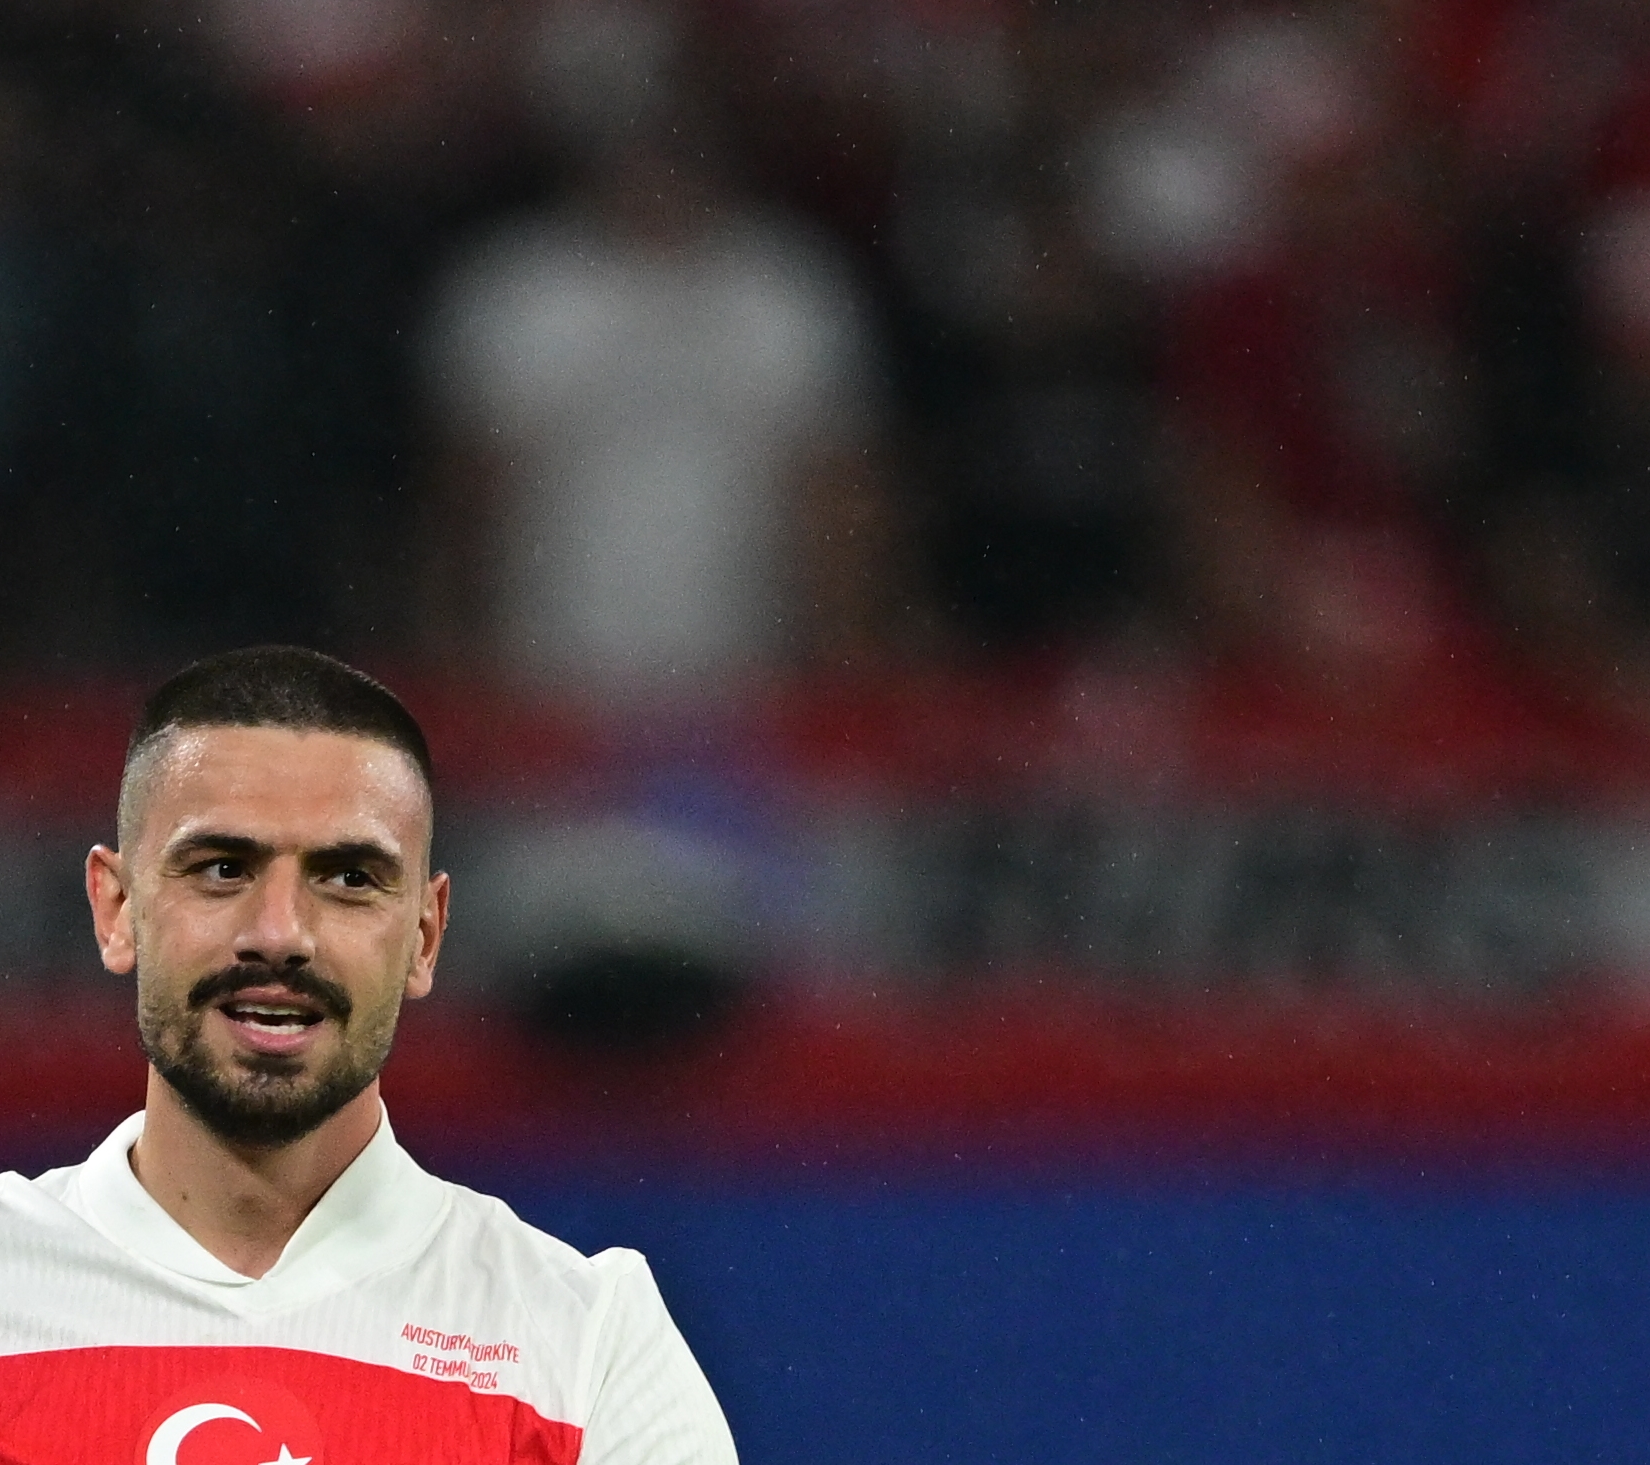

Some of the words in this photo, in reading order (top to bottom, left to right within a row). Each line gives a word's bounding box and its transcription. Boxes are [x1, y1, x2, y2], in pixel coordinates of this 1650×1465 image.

[400, 1322, 472, 1353] AVUSTURYA
[470, 1339, 520, 1364] TÜRKİYE
[412, 1353, 428, 1372] 02
[429, 1356, 471, 1378] TEMMU
[471, 1371, 499, 1390] 2024
